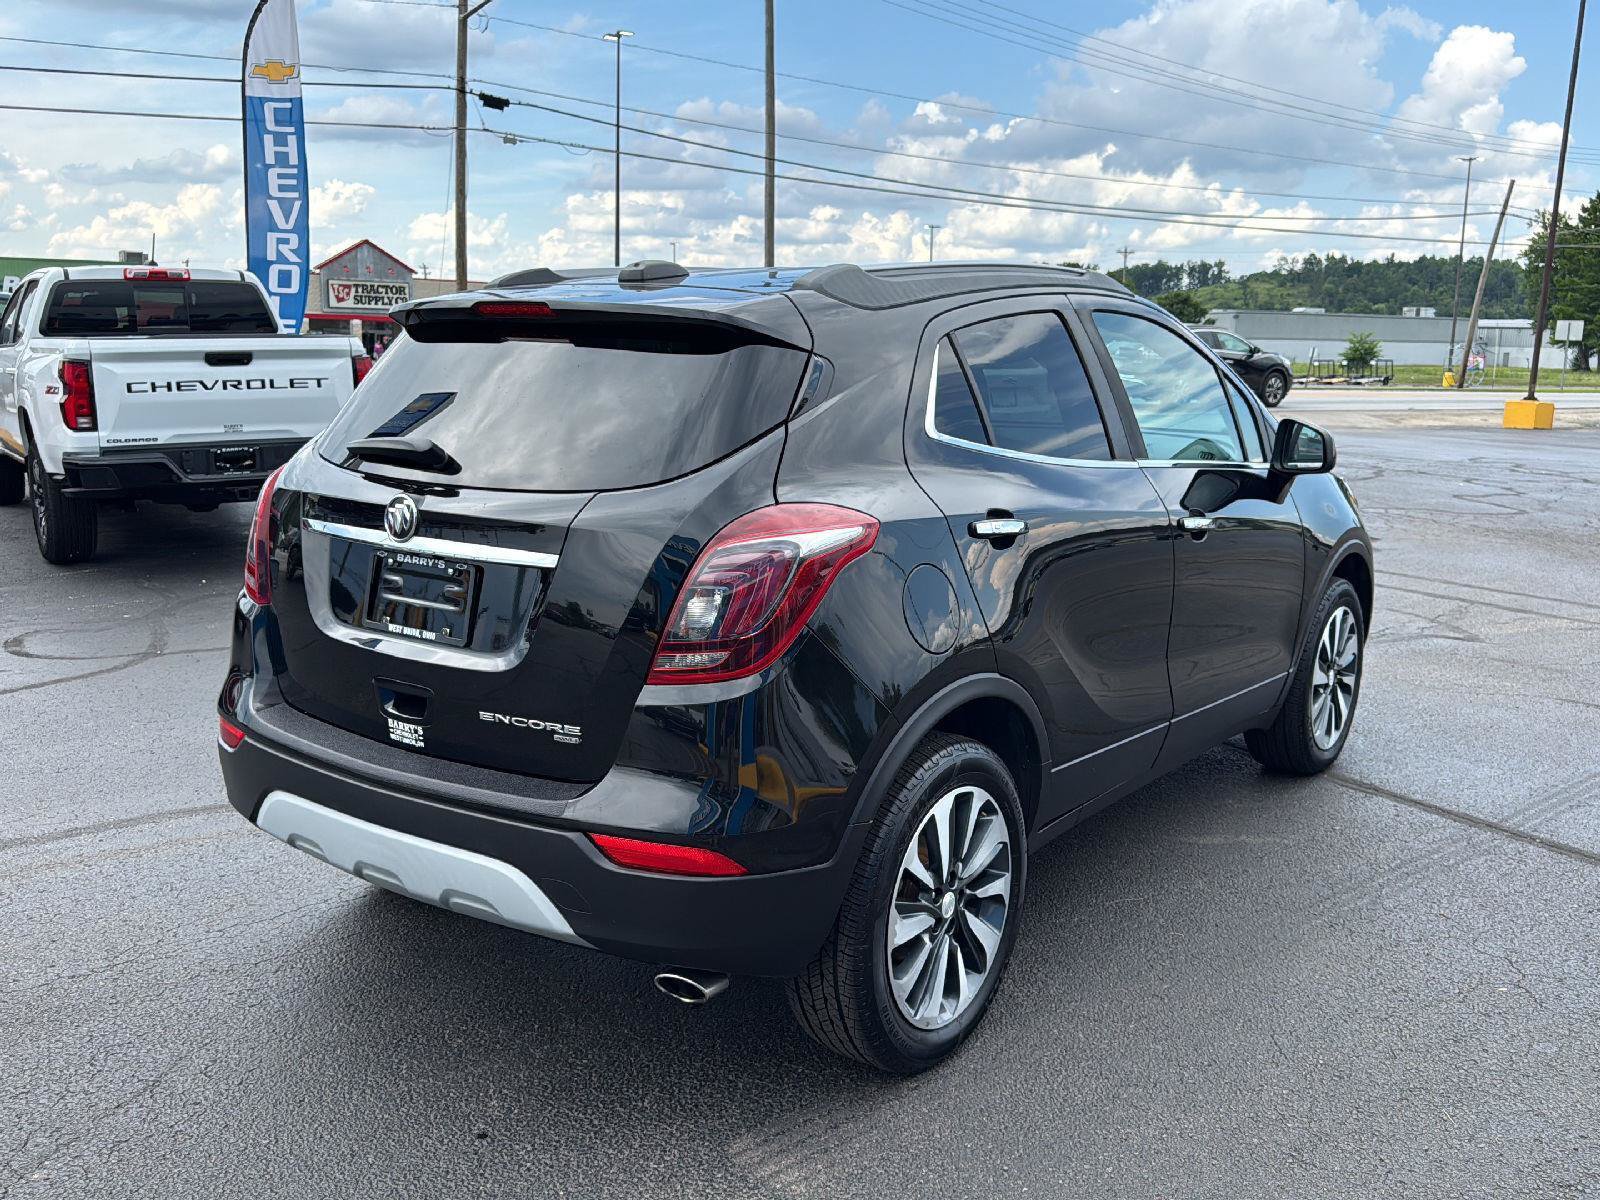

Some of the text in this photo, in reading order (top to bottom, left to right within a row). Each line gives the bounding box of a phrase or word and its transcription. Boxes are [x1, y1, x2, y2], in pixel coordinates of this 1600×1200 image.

[263, 101, 303, 334] CHEVROL
[331, 284, 350, 300] TSC
[353, 283, 407, 295] TRACTOR
[353, 295, 394, 305] SUPPLY
[126, 377, 329, 394] CHEVROLET
[396, 553, 446, 568] BARRY'S
[388, 718, 423, 735] BARRY'S
[479, 711, 582, 735] ENCORE
